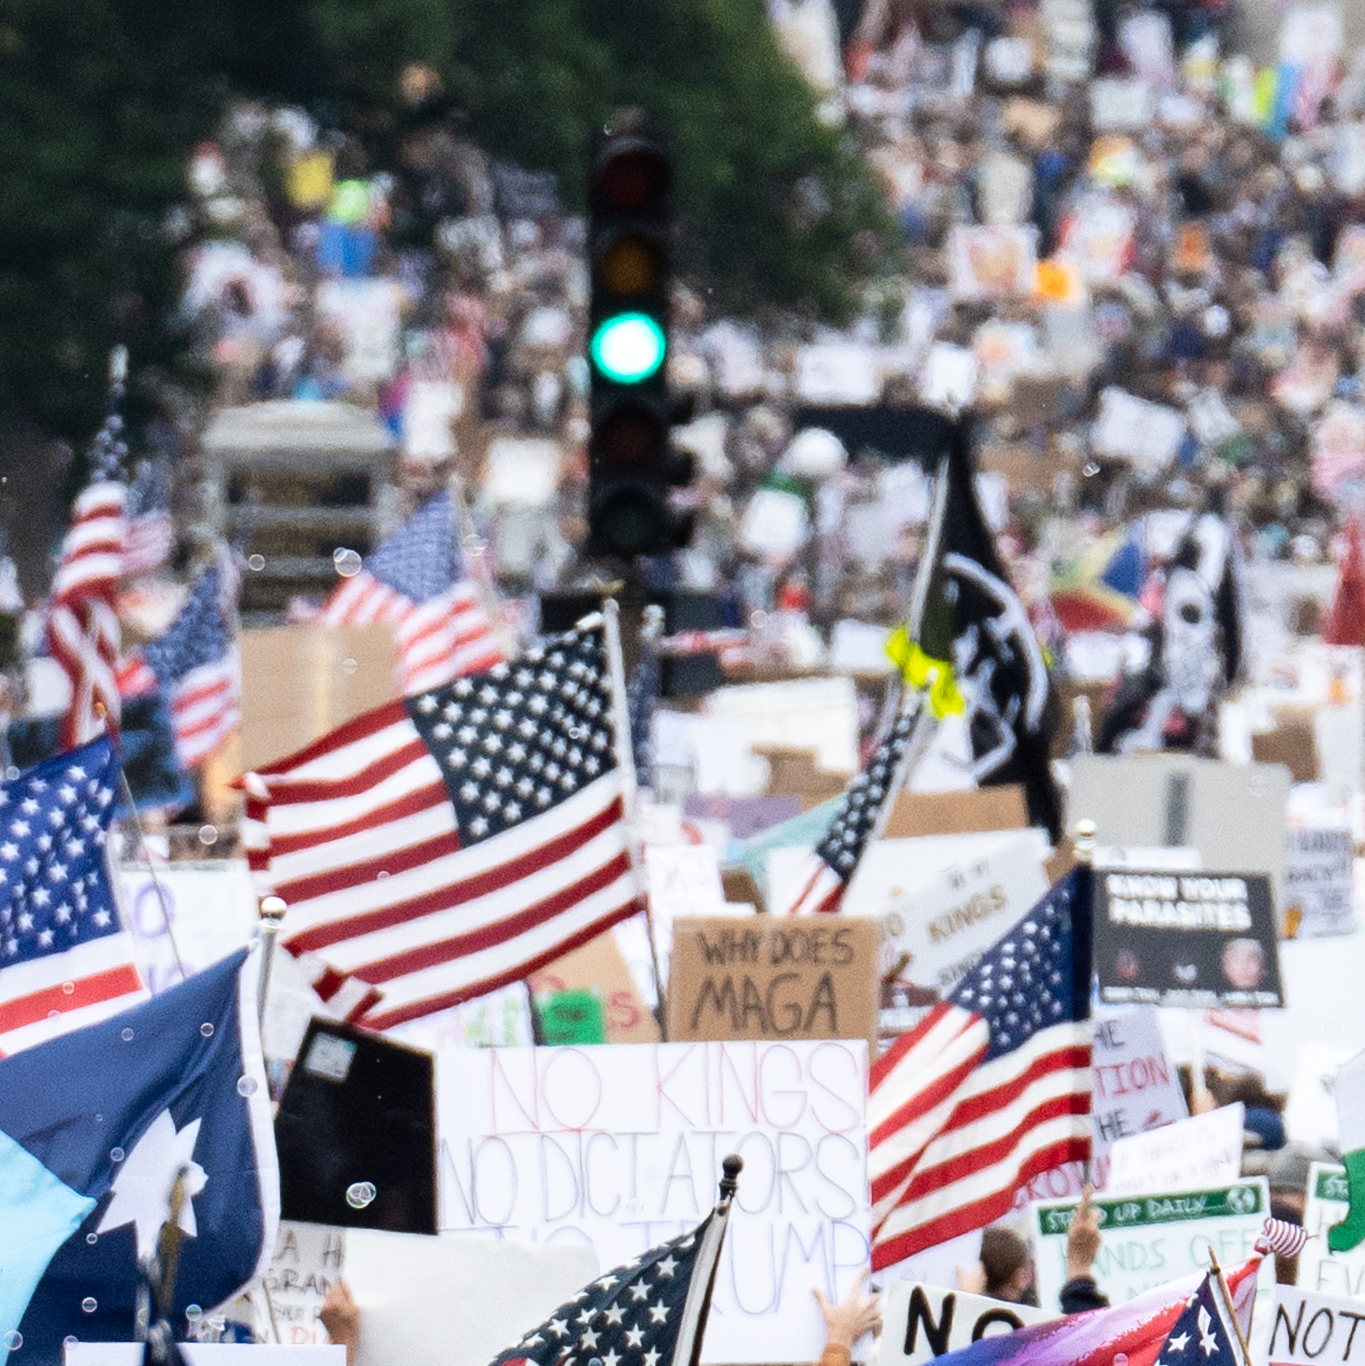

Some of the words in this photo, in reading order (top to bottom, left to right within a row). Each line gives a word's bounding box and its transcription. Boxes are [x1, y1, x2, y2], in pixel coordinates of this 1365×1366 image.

[690, 972, 839, 1034] MAGA
[489, 1049, 601, 1131] NO
[656, 1042, 860, 1135] KINGS
[441, 1137, 518, 1227] NO
[541, 1132, 860, 1222] DICTATORS
